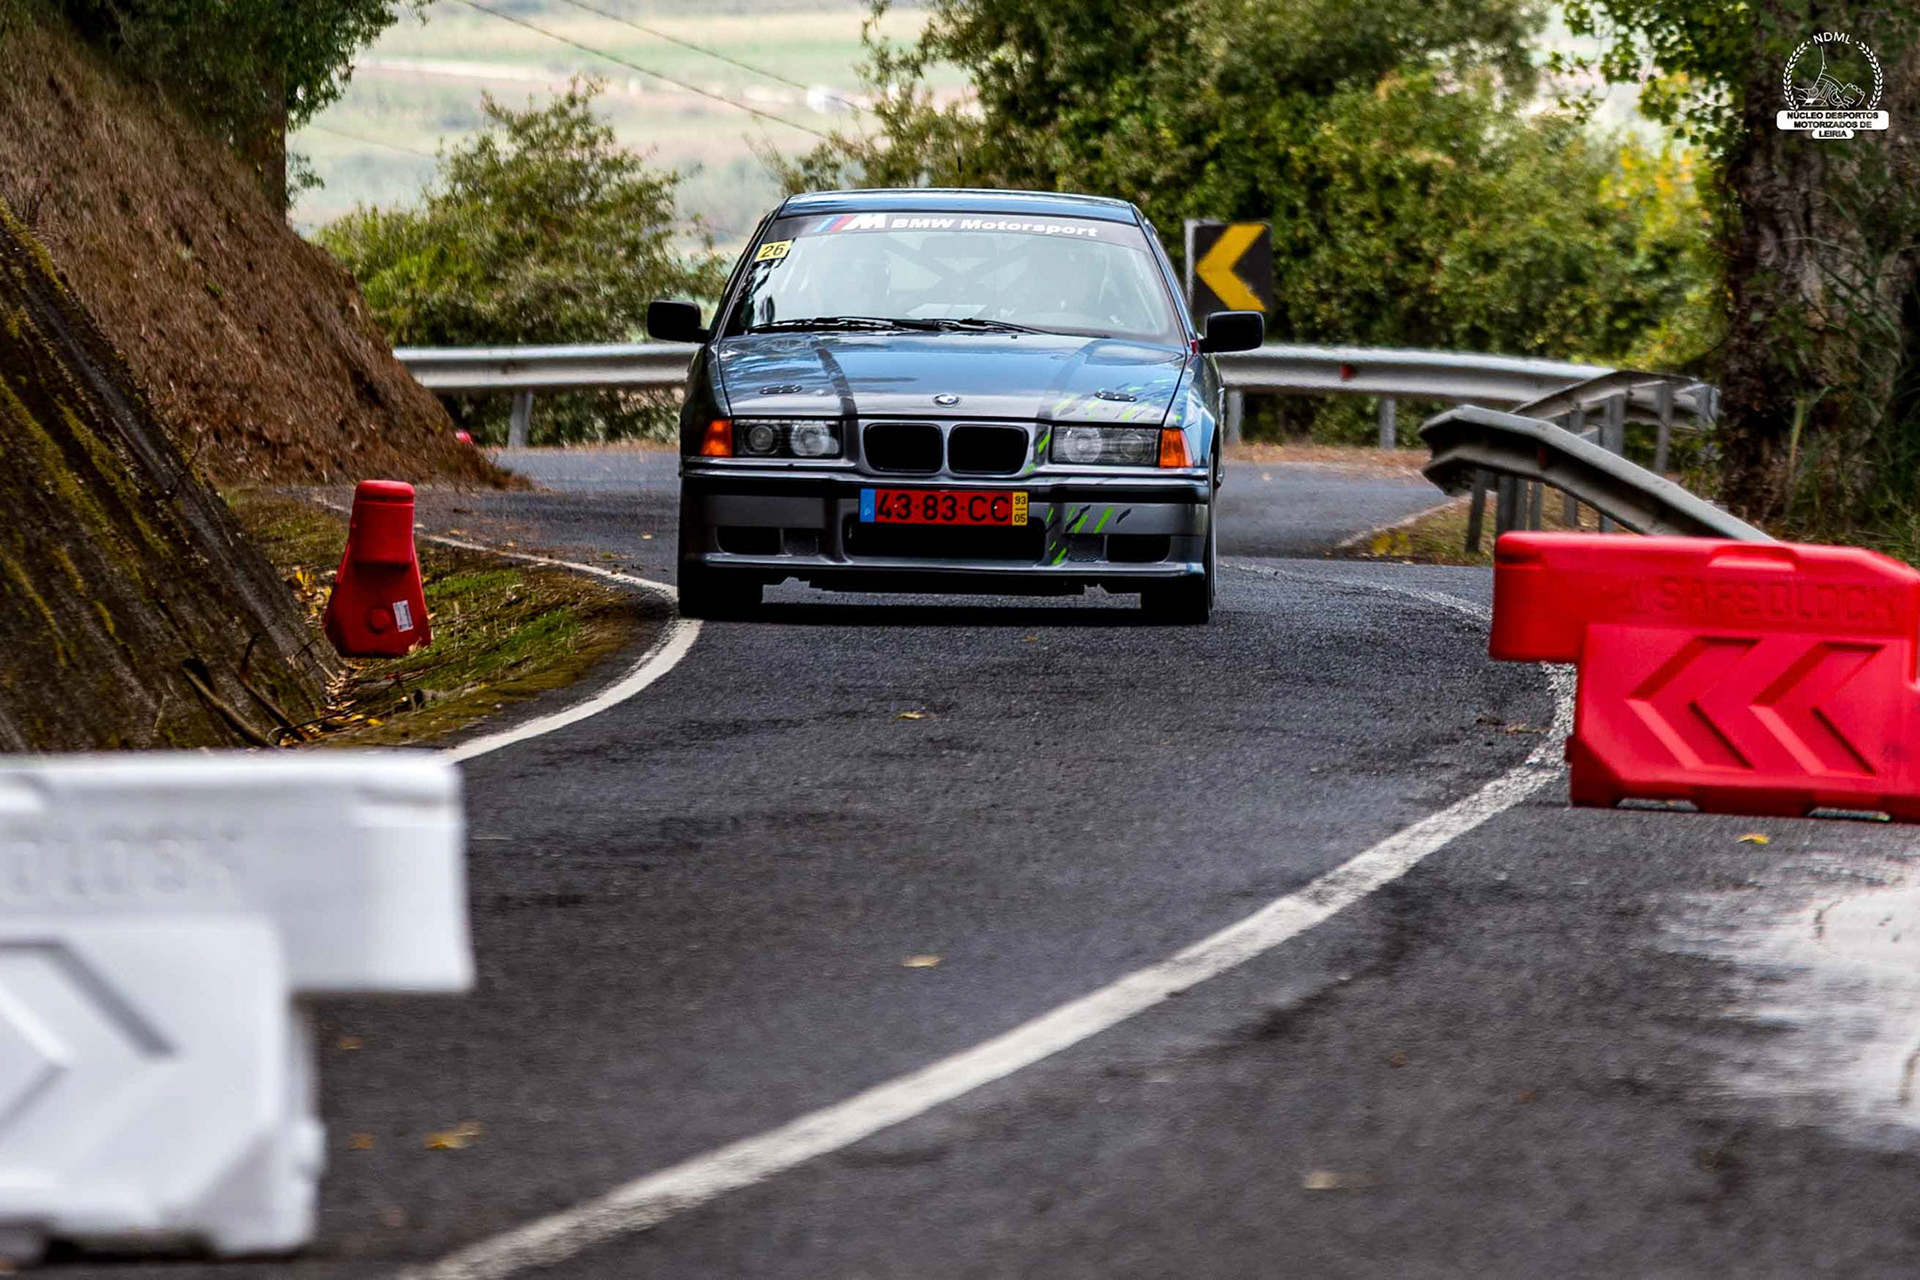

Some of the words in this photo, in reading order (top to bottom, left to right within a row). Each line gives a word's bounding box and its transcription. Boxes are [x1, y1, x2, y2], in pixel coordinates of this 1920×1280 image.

[890, 218, 956, 230] BMW
[959, 218, 1099, 237] Motorsport
[759, 243, 787, 259] 26
[1013, 513, 1027, 524] 05
